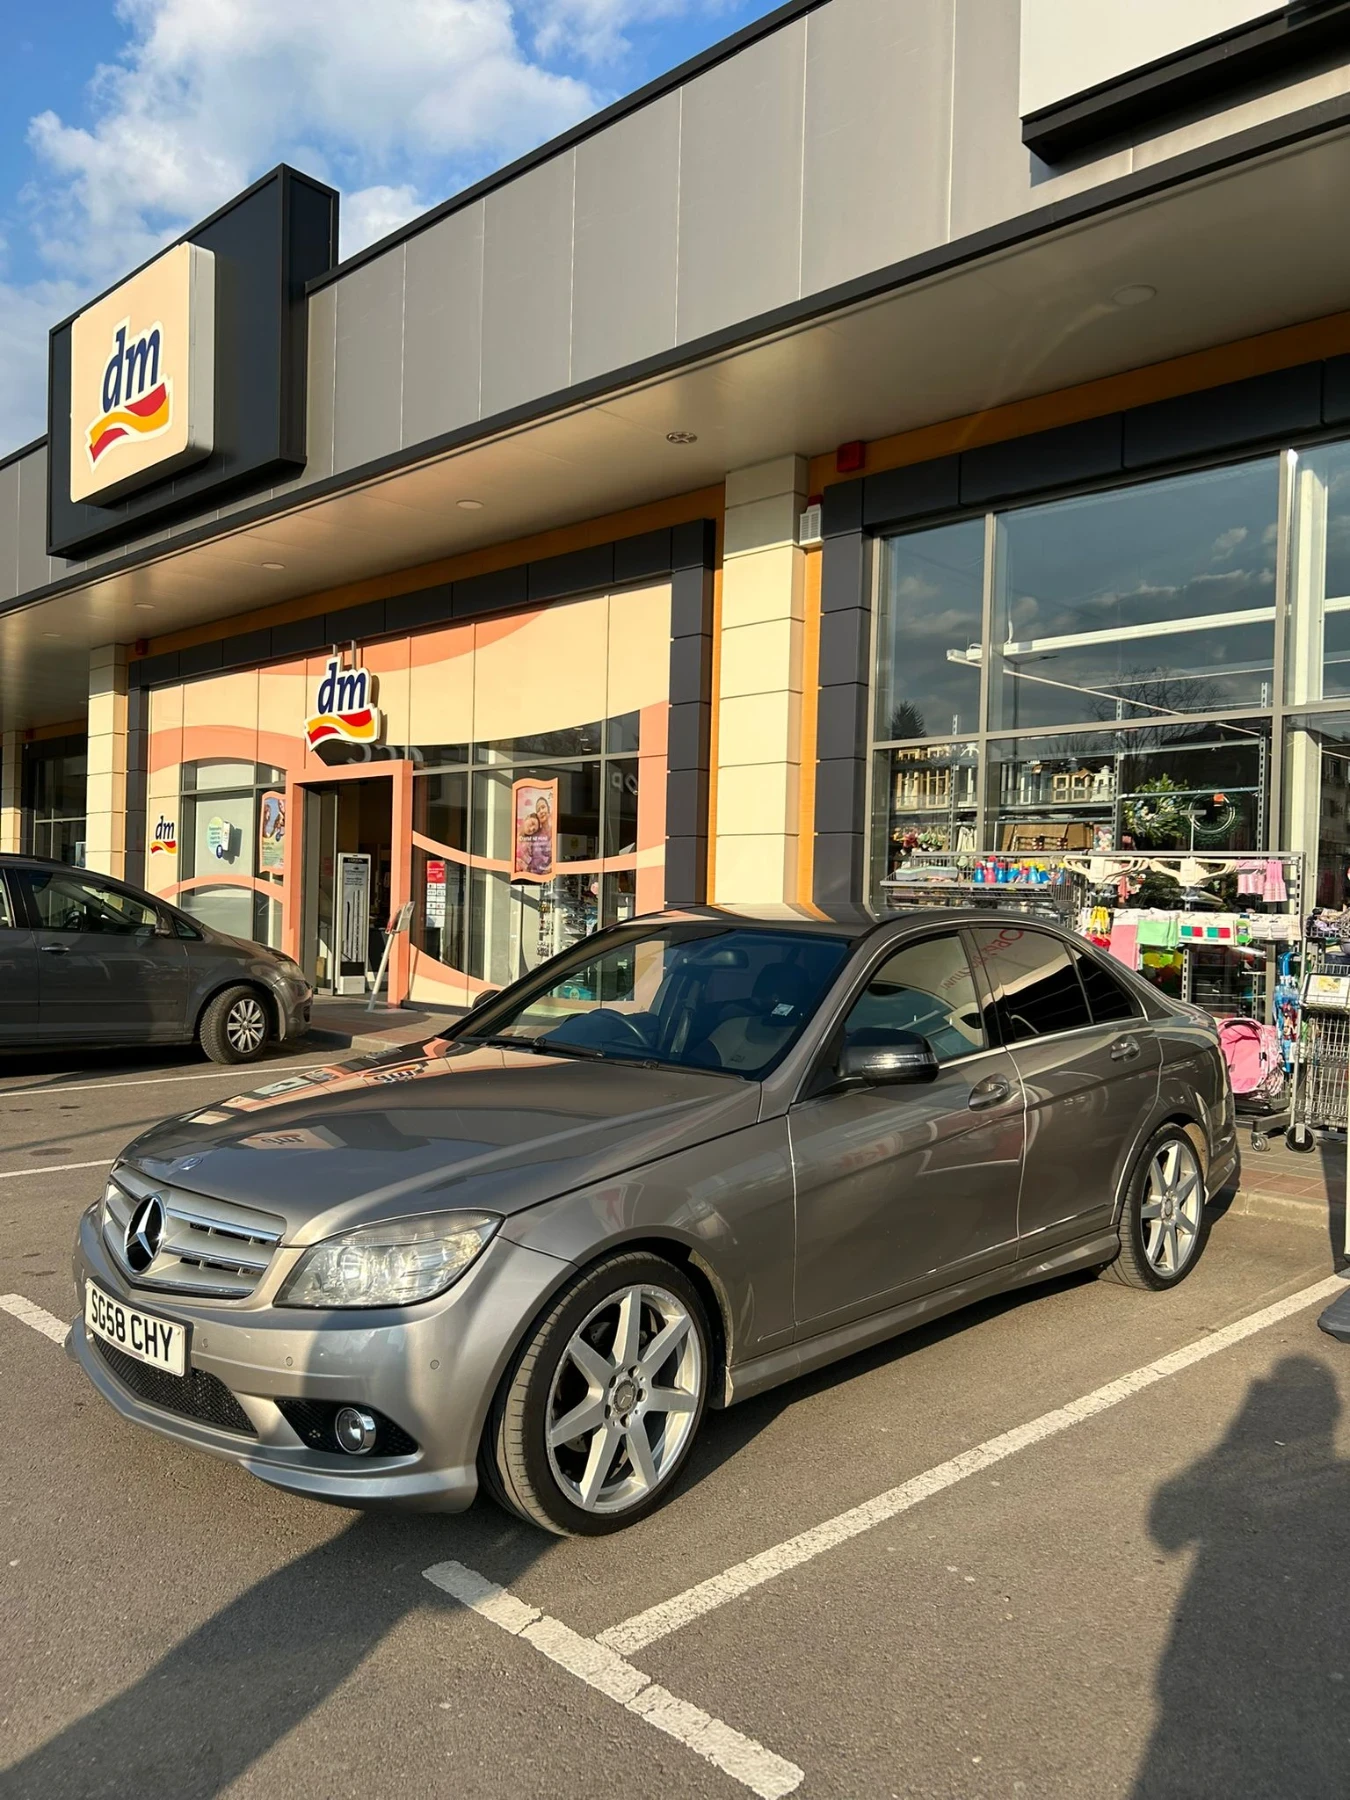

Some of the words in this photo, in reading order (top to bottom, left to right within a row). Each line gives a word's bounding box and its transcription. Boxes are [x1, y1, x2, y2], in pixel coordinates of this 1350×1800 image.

[102, 326, 160, 413] dm
[317, 661, 367, 715] dm
[155, 815, 175, 840] dm
[91, 1289, 126, 1343] SG58
[130, 1314, 173, 1362] CHY
